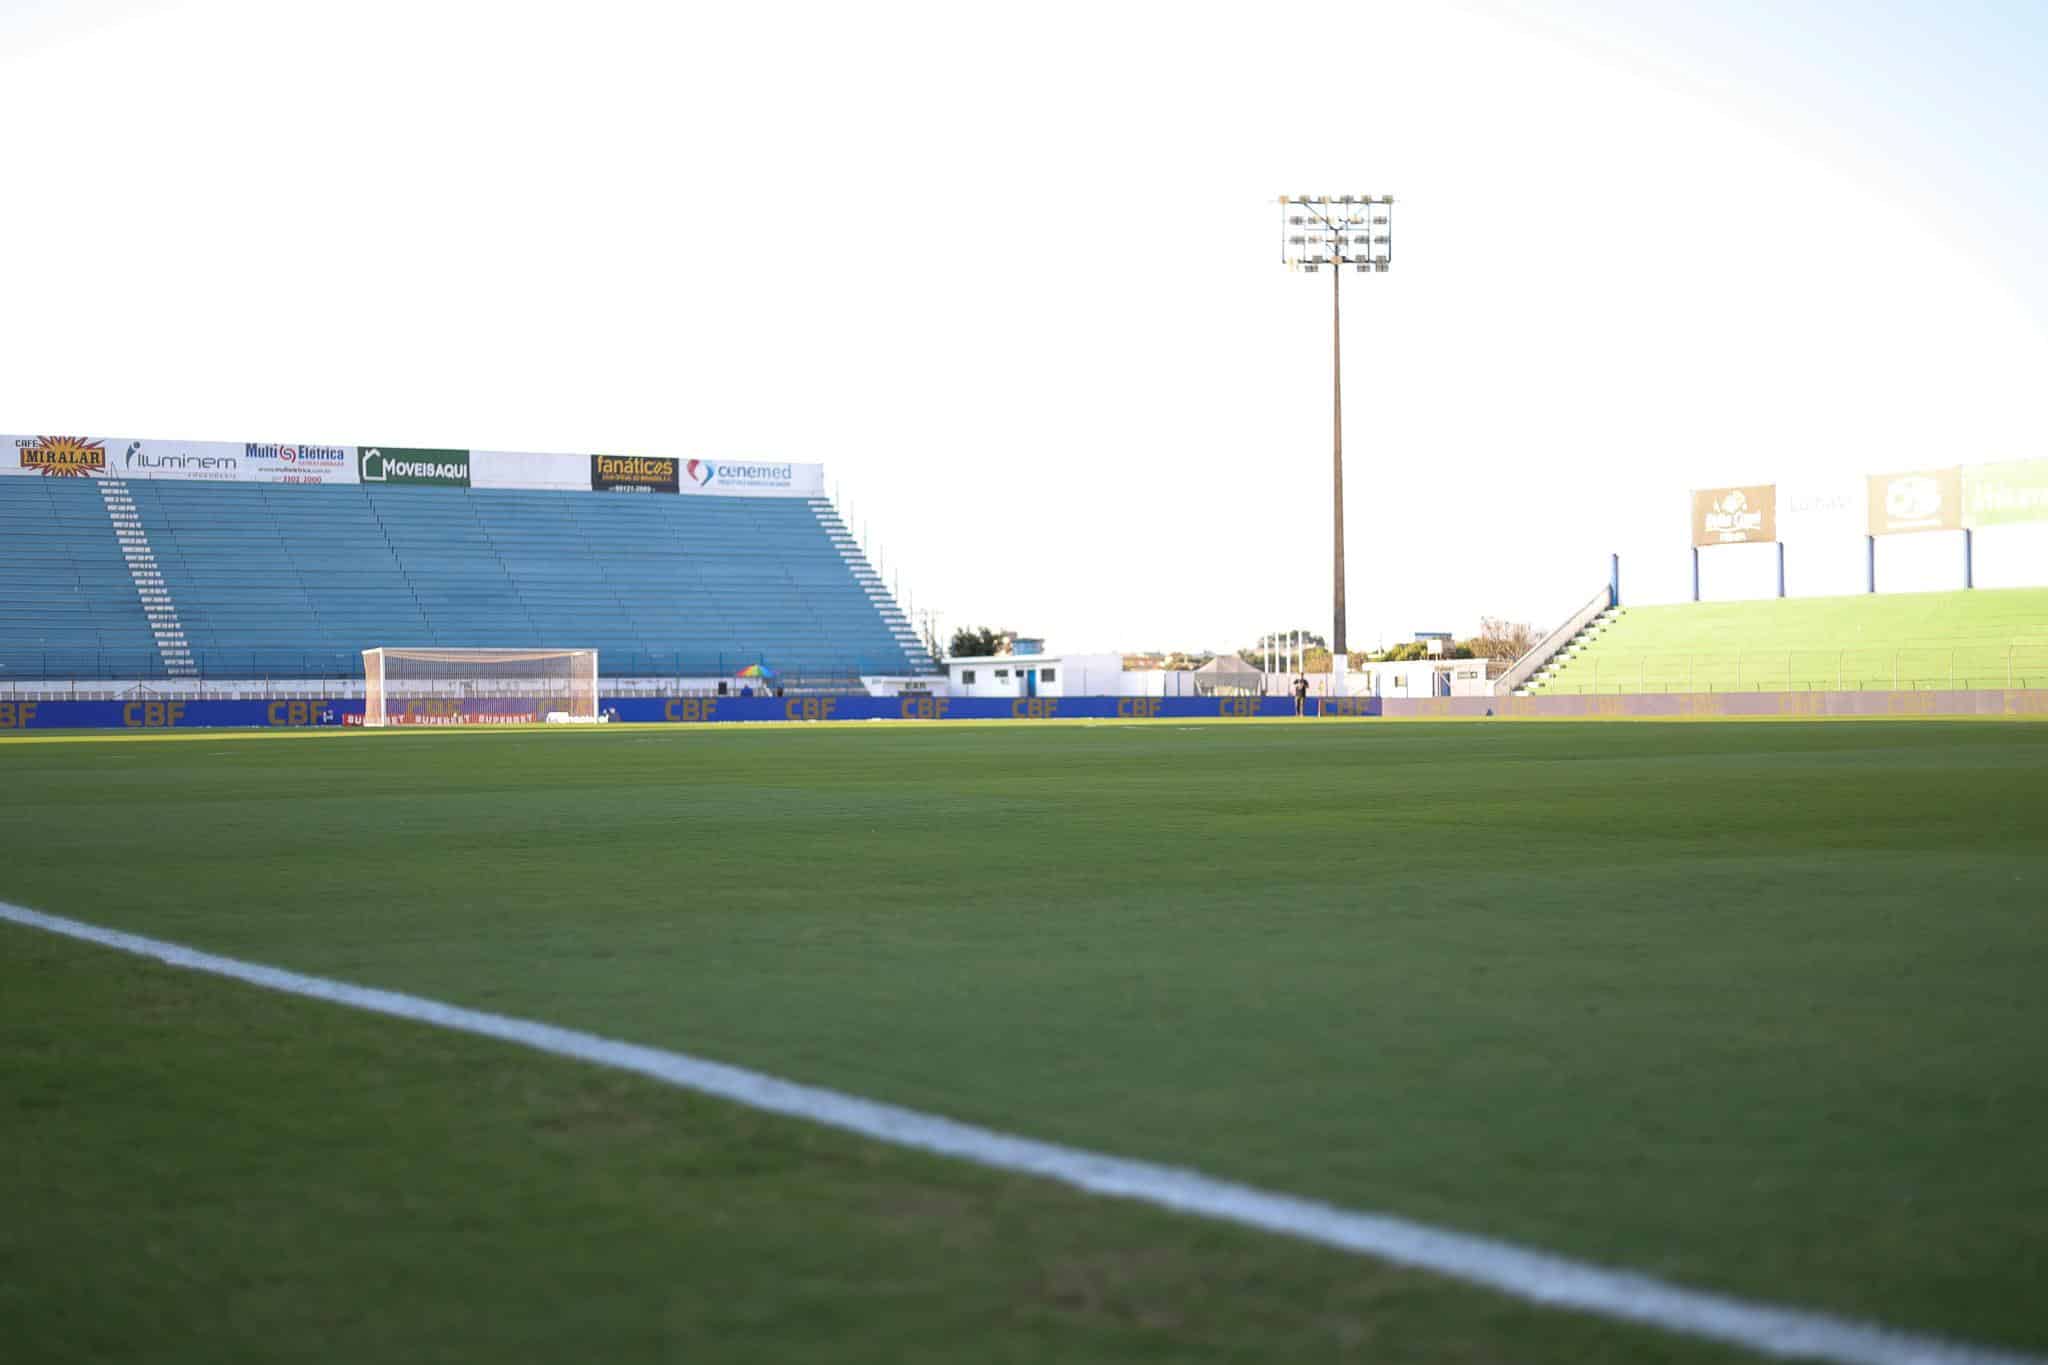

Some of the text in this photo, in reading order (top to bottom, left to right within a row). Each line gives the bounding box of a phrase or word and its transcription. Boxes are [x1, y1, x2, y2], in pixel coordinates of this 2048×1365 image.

[25, 450, 100, 464] MIRALAR
[246, 443, 277, 458] Multi
[598, 455, 673, 475] fanáticos
[718, 463, 791, 480] cenemed
[125, 702, 186, 727] CBF
[268, 701, 328, 725] CBF
[665, 698, 715, 721] CBF
[786, 698, 836, 721] CBF
[902, 697, 949, 720] CBF
[1012, 698, 1058, 719] CBF
[1118, 698, 1162, 719] CBF
[1219, 698, 1262, 718] CBF
